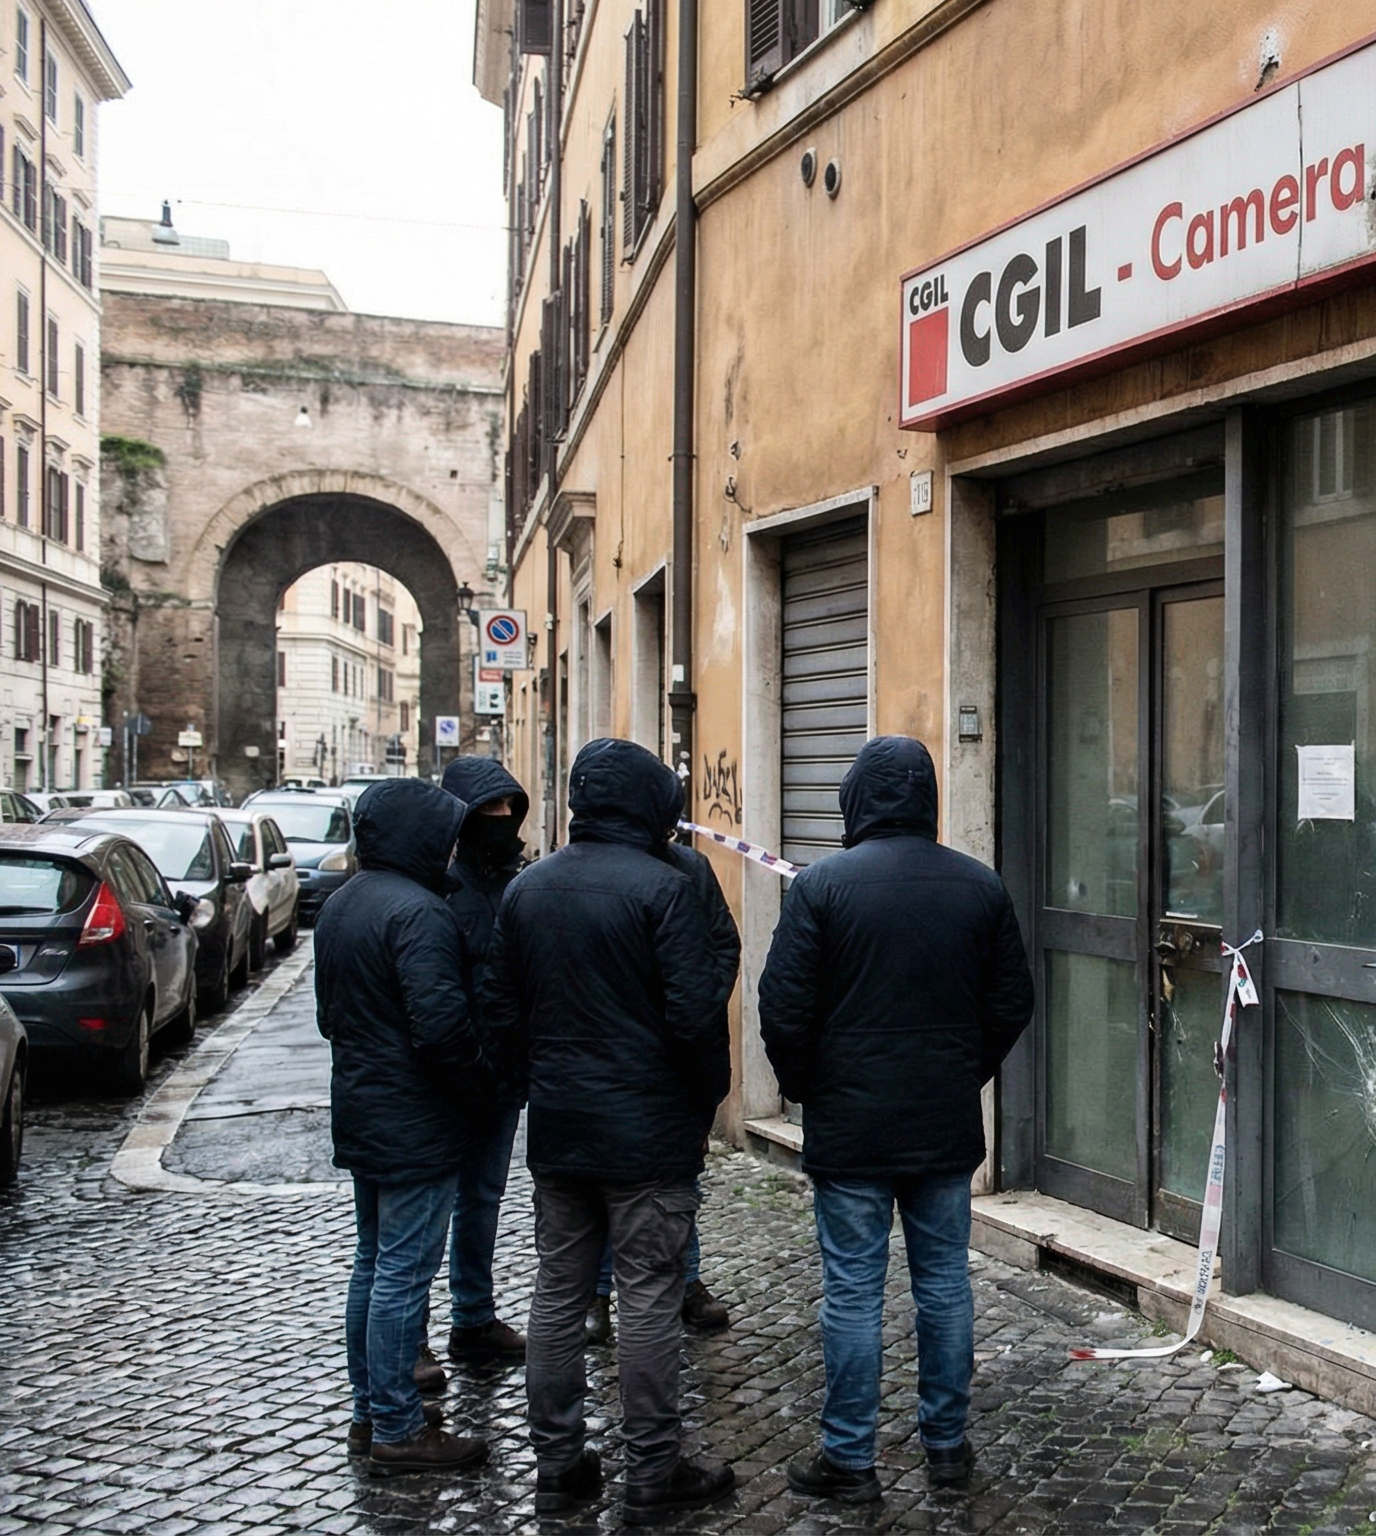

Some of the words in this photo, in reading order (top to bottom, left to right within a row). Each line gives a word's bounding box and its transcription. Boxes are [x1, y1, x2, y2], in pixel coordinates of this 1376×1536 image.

[909, 274, 949, 316] CGIL
[960, 225, 1101, 366] CGIL
[1151, 144, 1365, 280] Camera
